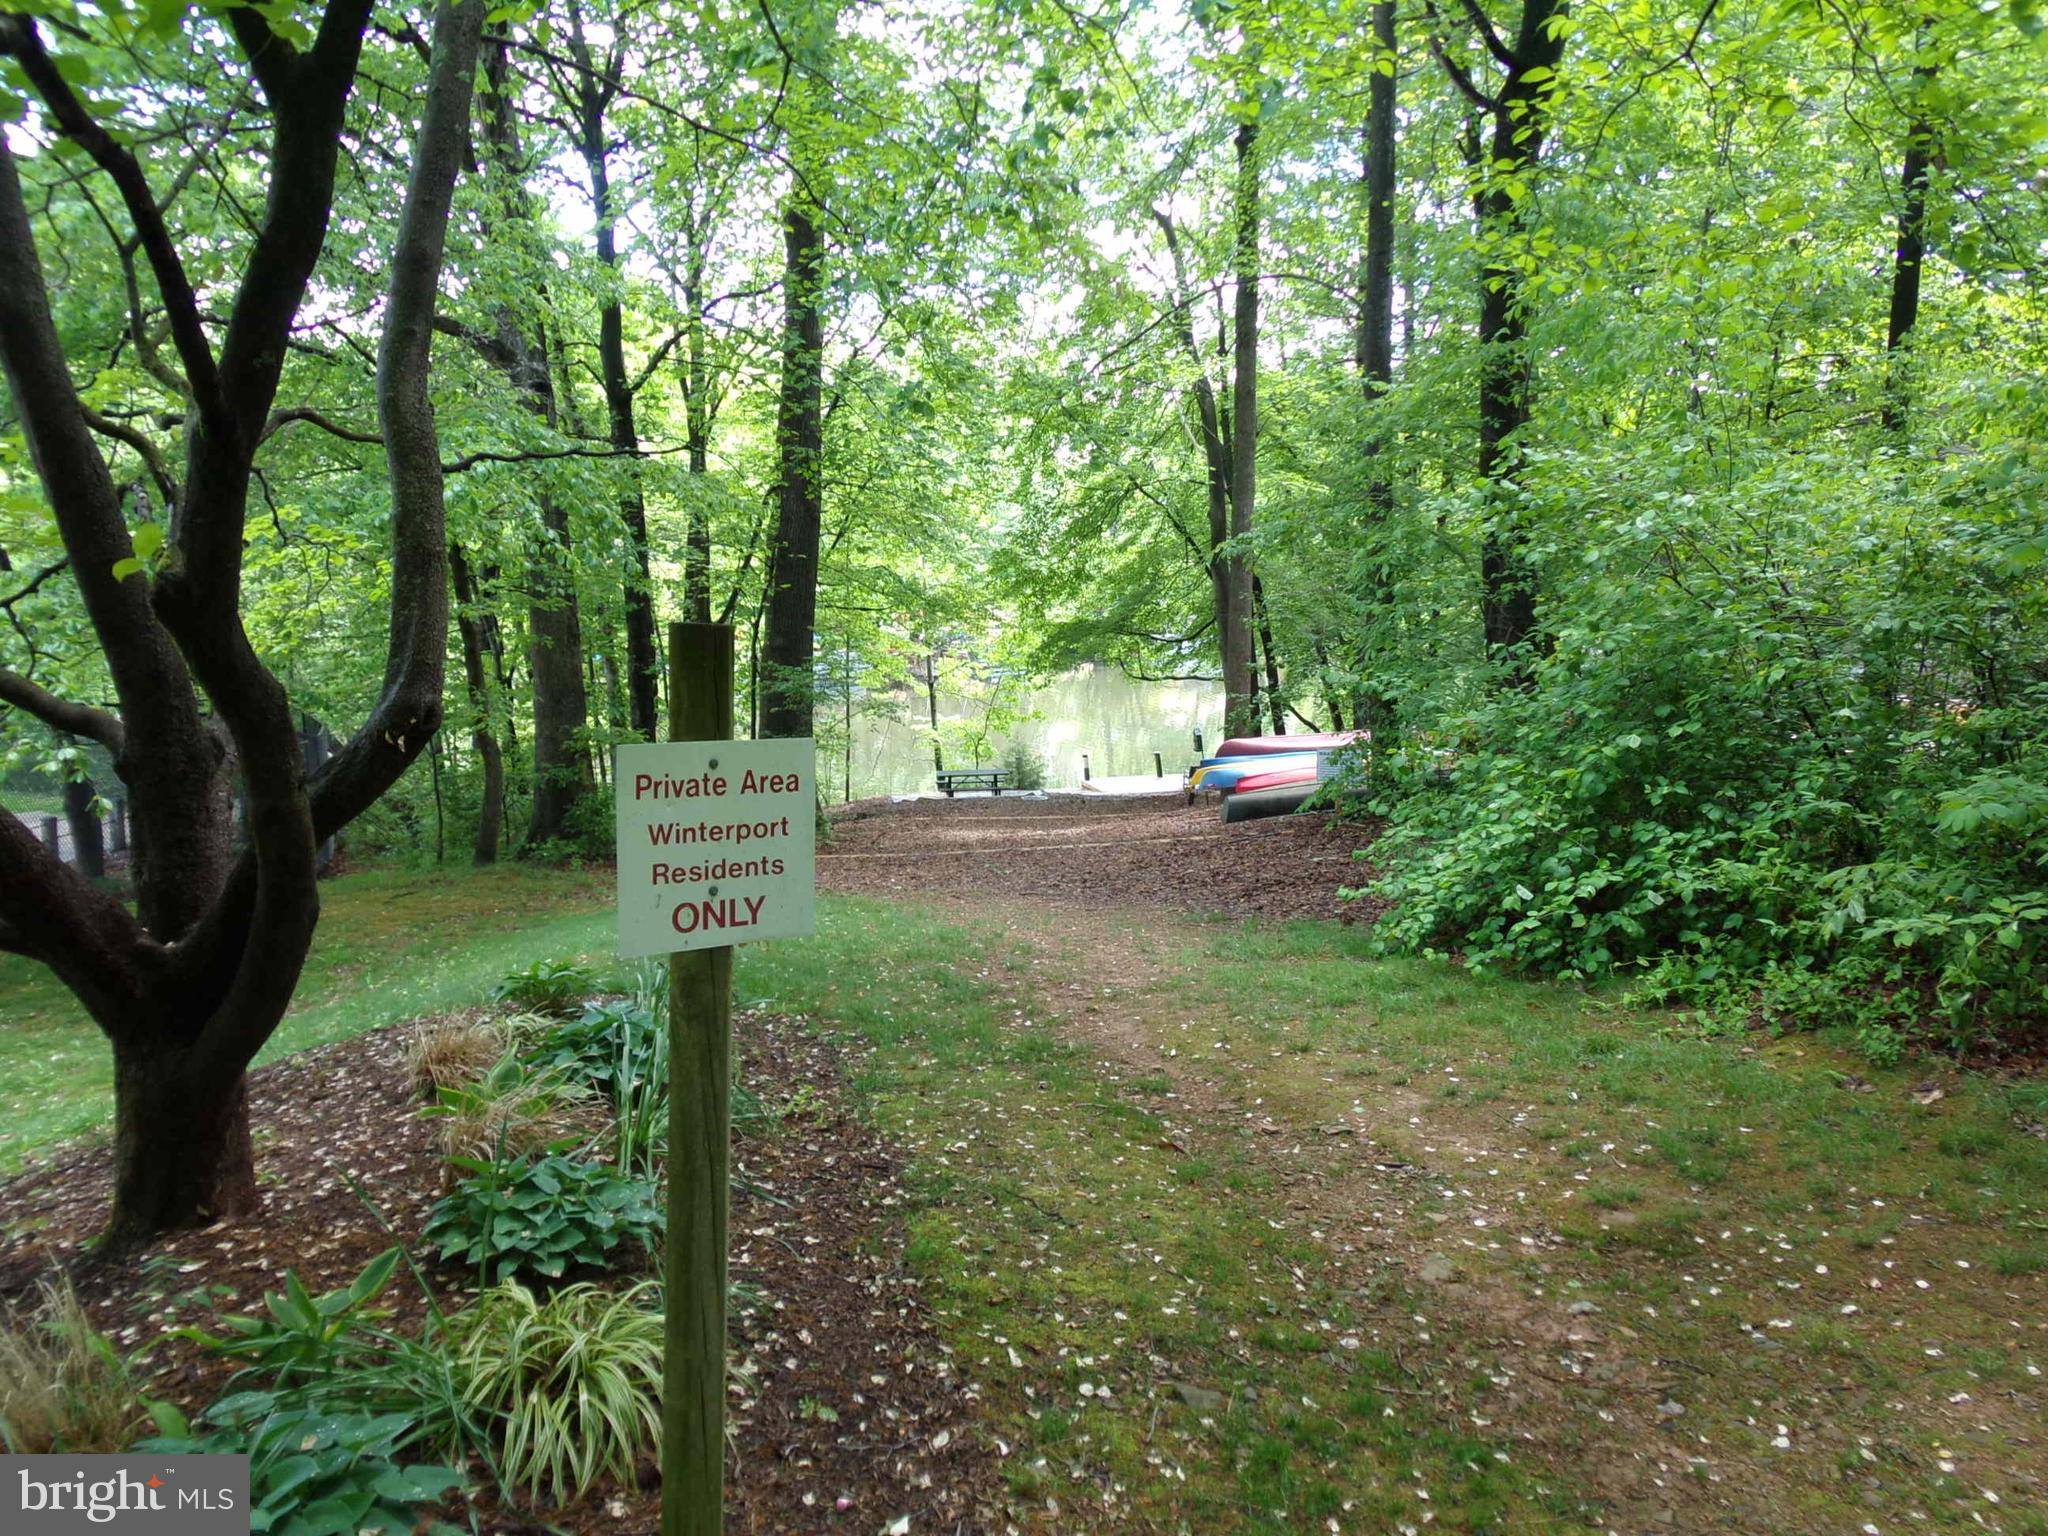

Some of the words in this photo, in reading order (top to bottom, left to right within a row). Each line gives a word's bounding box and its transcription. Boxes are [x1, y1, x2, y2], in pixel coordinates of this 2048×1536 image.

[635, 773, 727, 799] Private
[740, 769, 800, 795] Area
[648, 816, 789, 845] Winterport
[652, 856, 784, 885] Residents
[672, 895, 766, 934] ONLY
